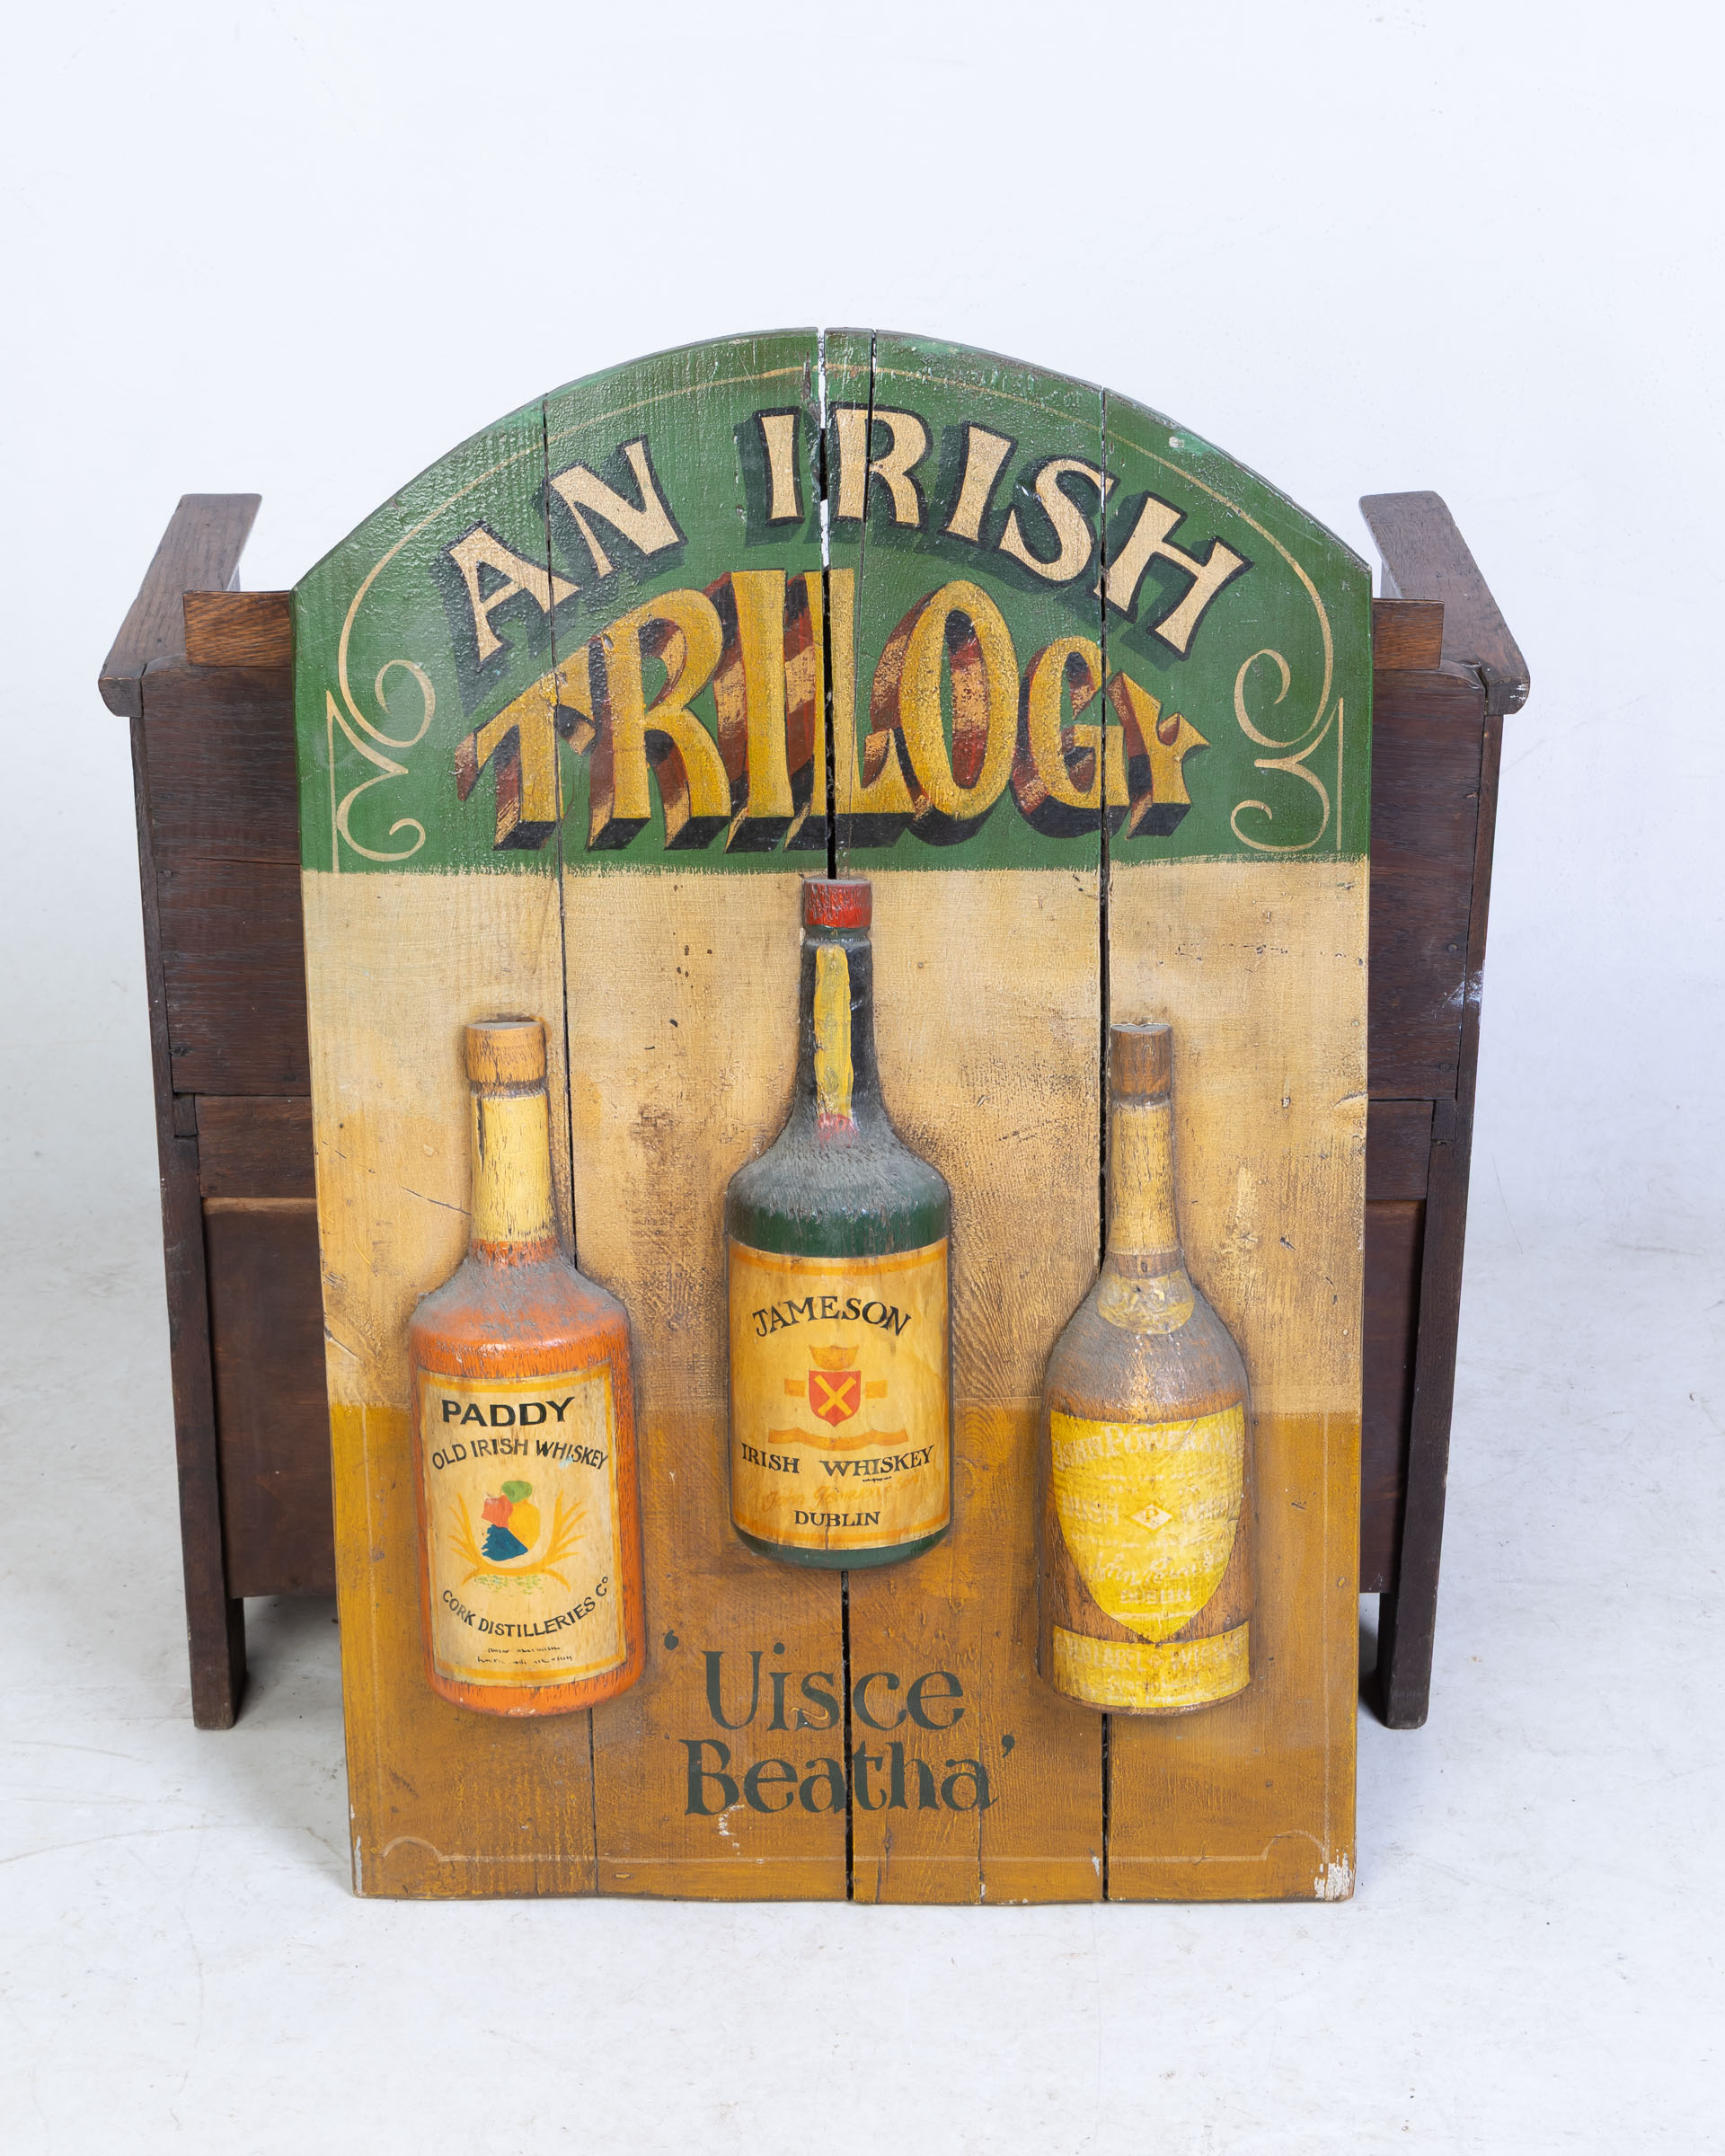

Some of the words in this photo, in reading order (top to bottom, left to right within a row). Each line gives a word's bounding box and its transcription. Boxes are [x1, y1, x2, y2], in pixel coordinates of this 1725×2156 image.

[438, 435, 688, 674] AN
[753, 401, 1255, 662] IRISH
[455, 568, 1210, 851] TRILOGY
[752, 1295, 912, 1337] JAMESON
[441, 1396, 575, 1427] PADDY
[432, 1444, 467, 1471] OLD
[470, 1437, 528, 1459] IRISH
[535, 1439, 609, 1471] WHISKEY
[741, 1443, 800, 1474] IRISH
[819, 1445, 934, 1477] WHISKEY
[794, 1509, 880, 1527] DUBLIN
[442, 1588, 475, 1628] CORK
[477, 1595, 597, 1639] DISTILLERIES
